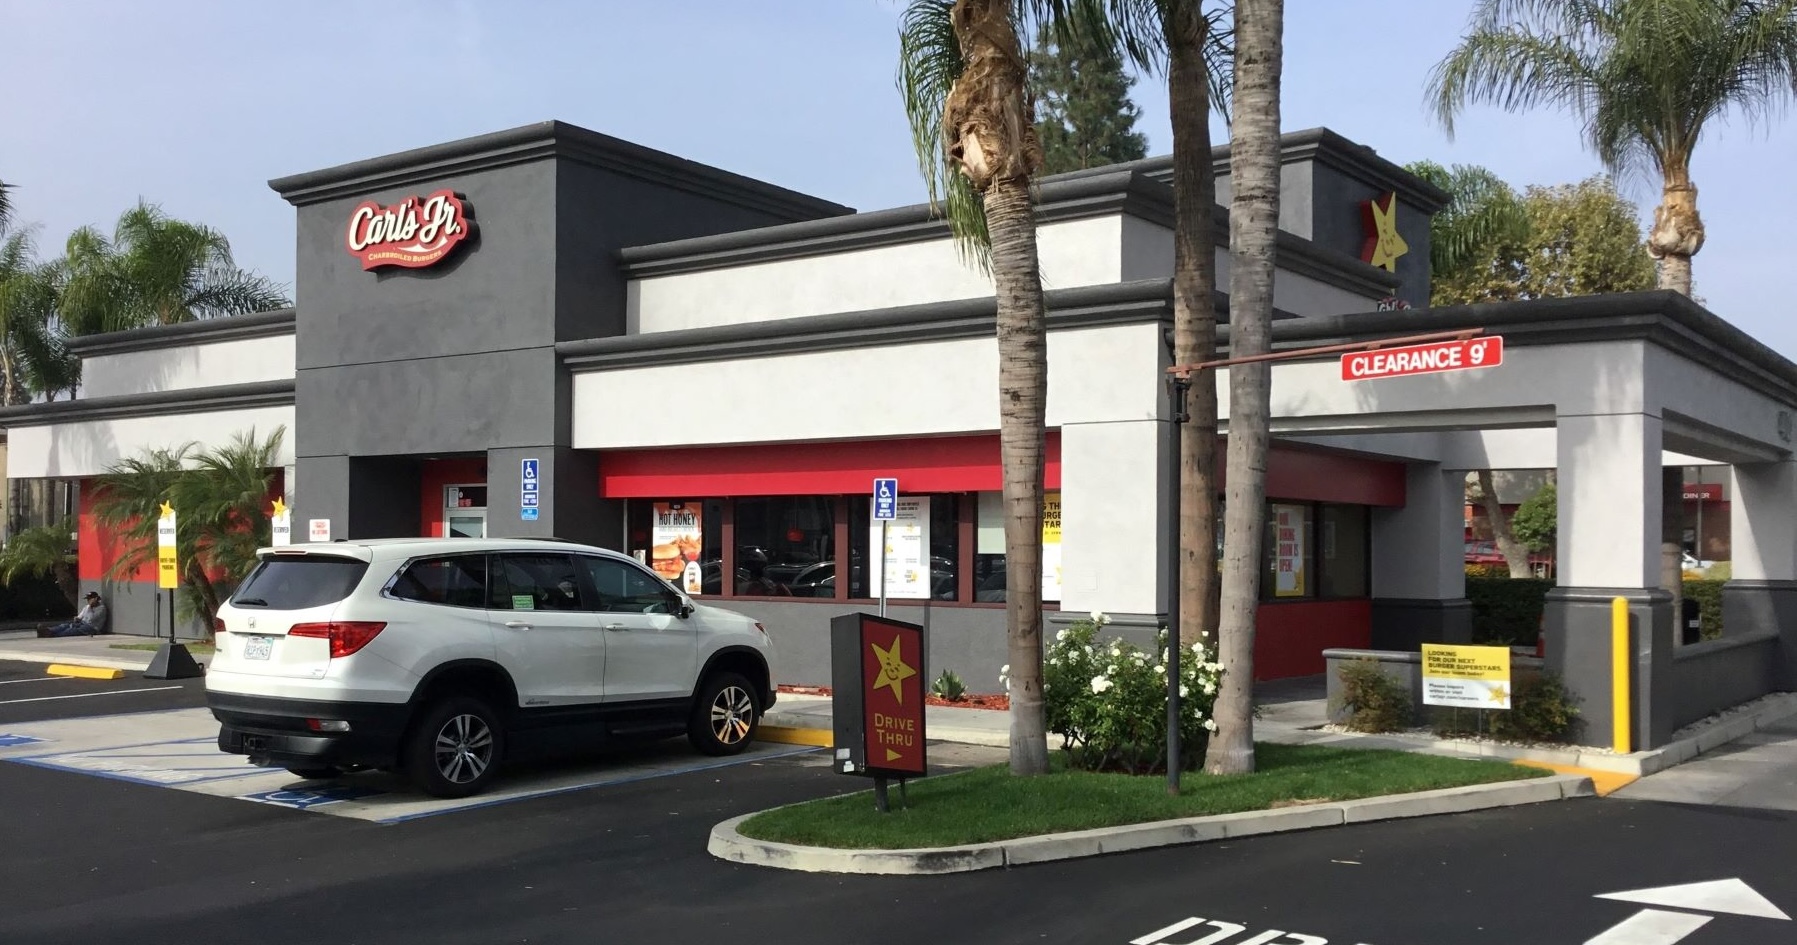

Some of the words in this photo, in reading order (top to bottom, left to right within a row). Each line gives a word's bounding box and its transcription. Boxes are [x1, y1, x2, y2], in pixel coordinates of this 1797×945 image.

[349, 199, 420, 251] Carl's
[419, 195, 461, 243] Jr.
[412, 251, 442, 262] BURGERS
[1351, 346, 1463, 377] CLEARANCE
[1470, 341, 1488, 365] 9'
[659, 513, 671, 525] HOT
[674, 513, 696, 525] HONEY
[875, 713, 914, 731] DRIVE
[877, 730, 913, 746] THRU
